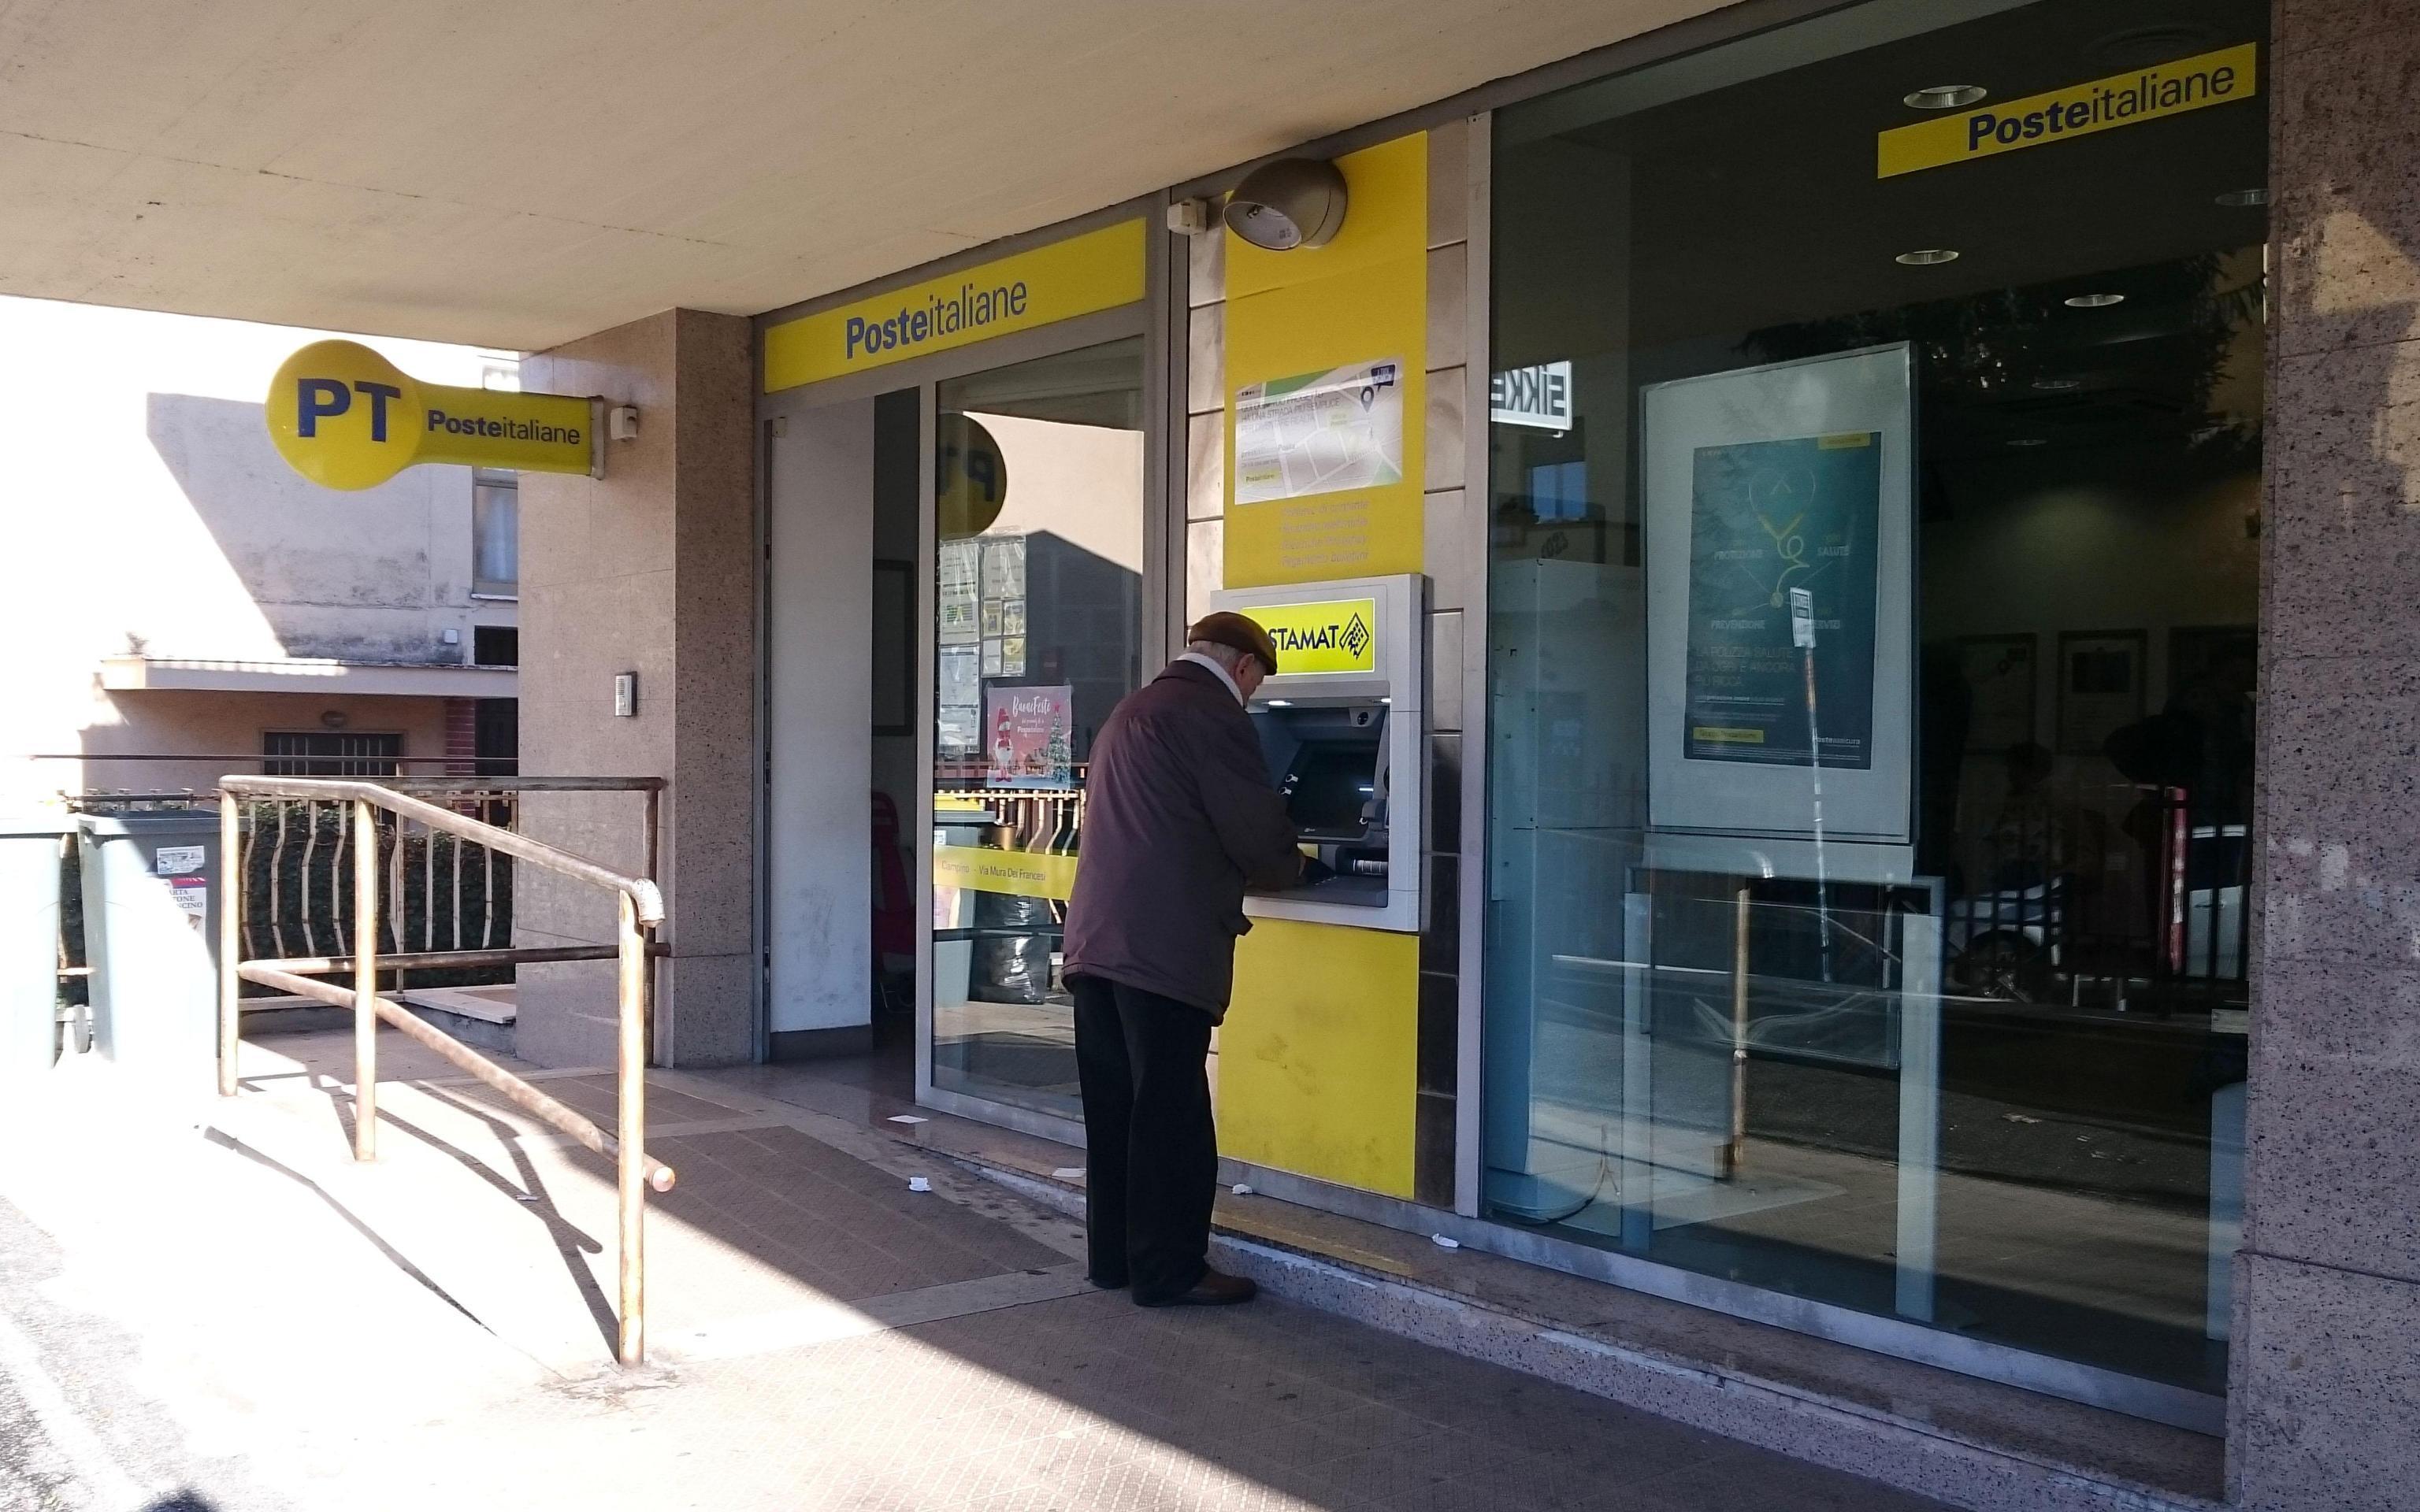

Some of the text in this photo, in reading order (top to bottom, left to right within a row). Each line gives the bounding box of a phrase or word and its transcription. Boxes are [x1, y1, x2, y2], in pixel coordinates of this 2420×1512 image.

[1969, 65, 2235, 151] Posteitaliane
[846, 281, 1027, 360] Posteitaliane
[298, 378, 401, 443] PT
[428, 410, 580, 445] Posteitaliane
[979, 865, 989, 876] Via
[989, 866, 1006, 877] Mura
[1008, 867, 1018, 877] Dei
[1019, 869, 1046, 881] Francesi
